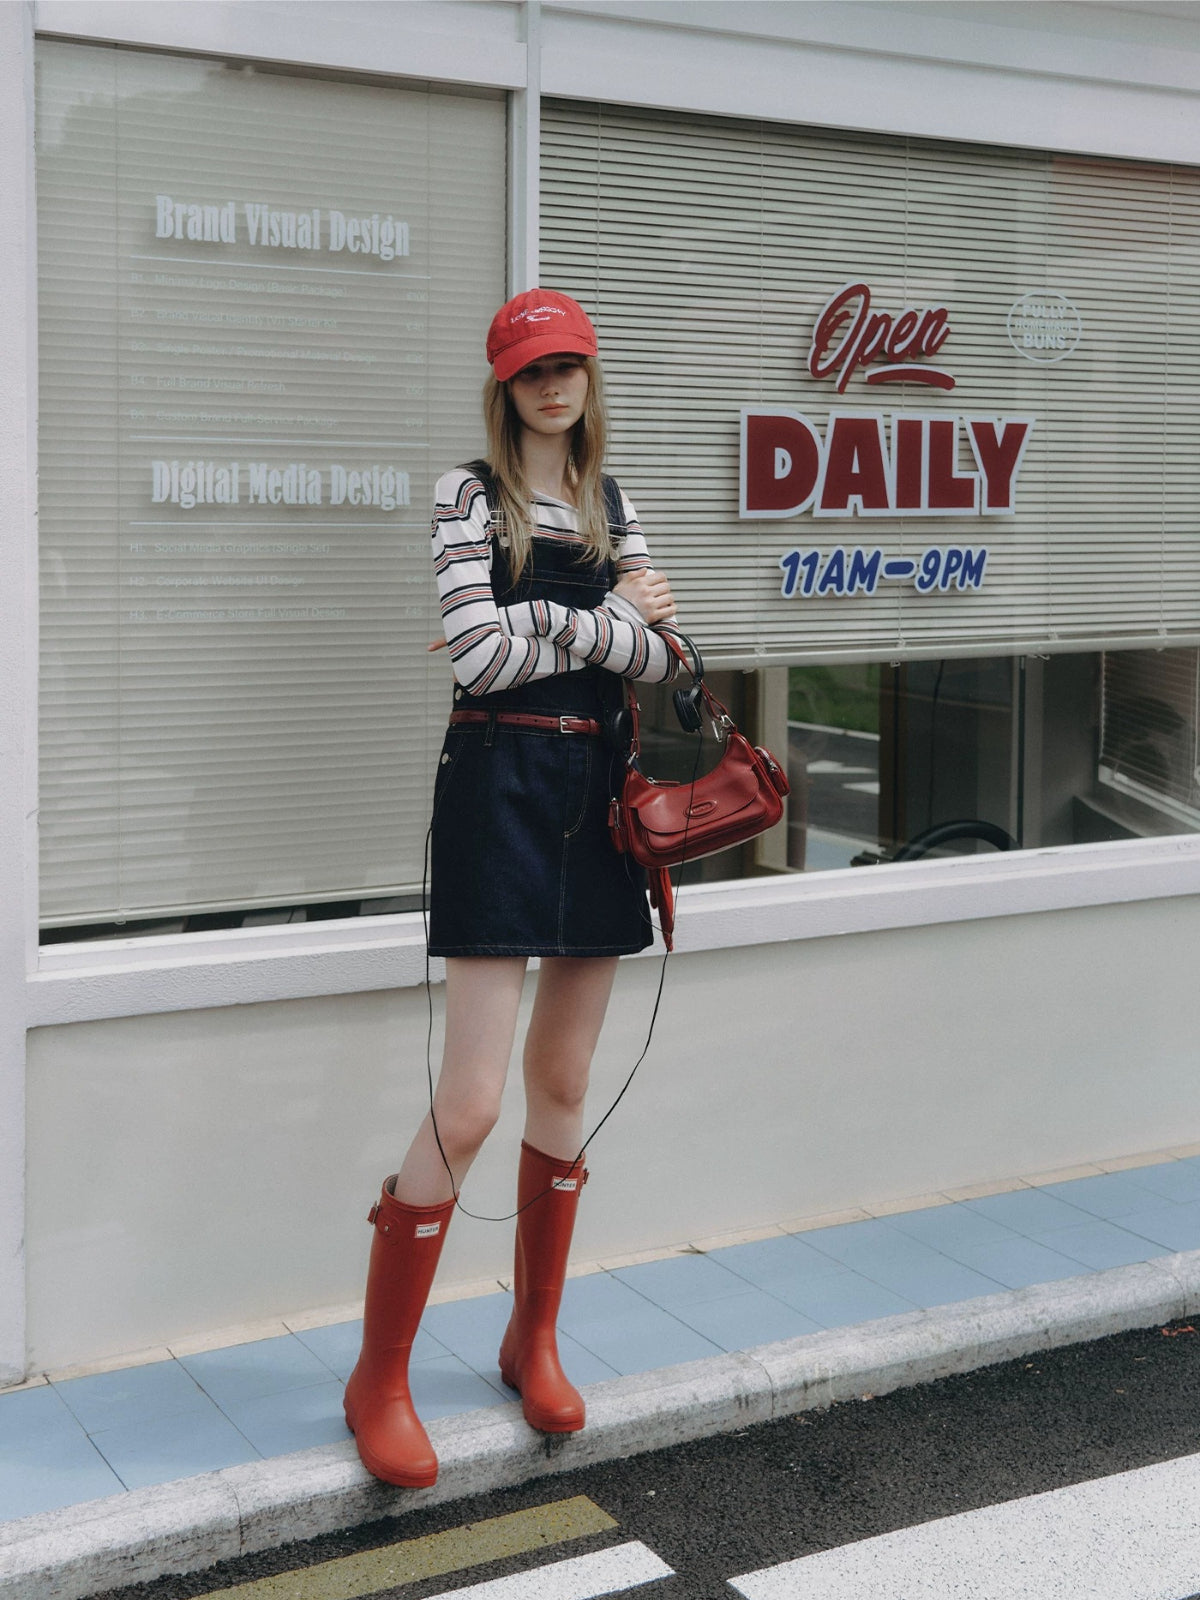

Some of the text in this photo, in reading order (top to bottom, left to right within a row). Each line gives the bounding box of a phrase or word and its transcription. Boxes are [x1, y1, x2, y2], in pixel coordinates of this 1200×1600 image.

[156, 194, 410, 261] Brand Visual Design
[1023, 304, 1066, 319] FULLY
[807, 280, 951, 395] Open
[1023, 333, 1066, 350] BUNS
[740, 408, 1035, 519] DAILY
[151, 461, 410, 511] Digital Media Design
[154, 543, 186, 553] Social
[157, 575, 208, 588] Corporate
[258, 607, 276, 618] Full
[311, 607, 347, 619] Design
[416, 1226, 439, 1235] HUNTER
